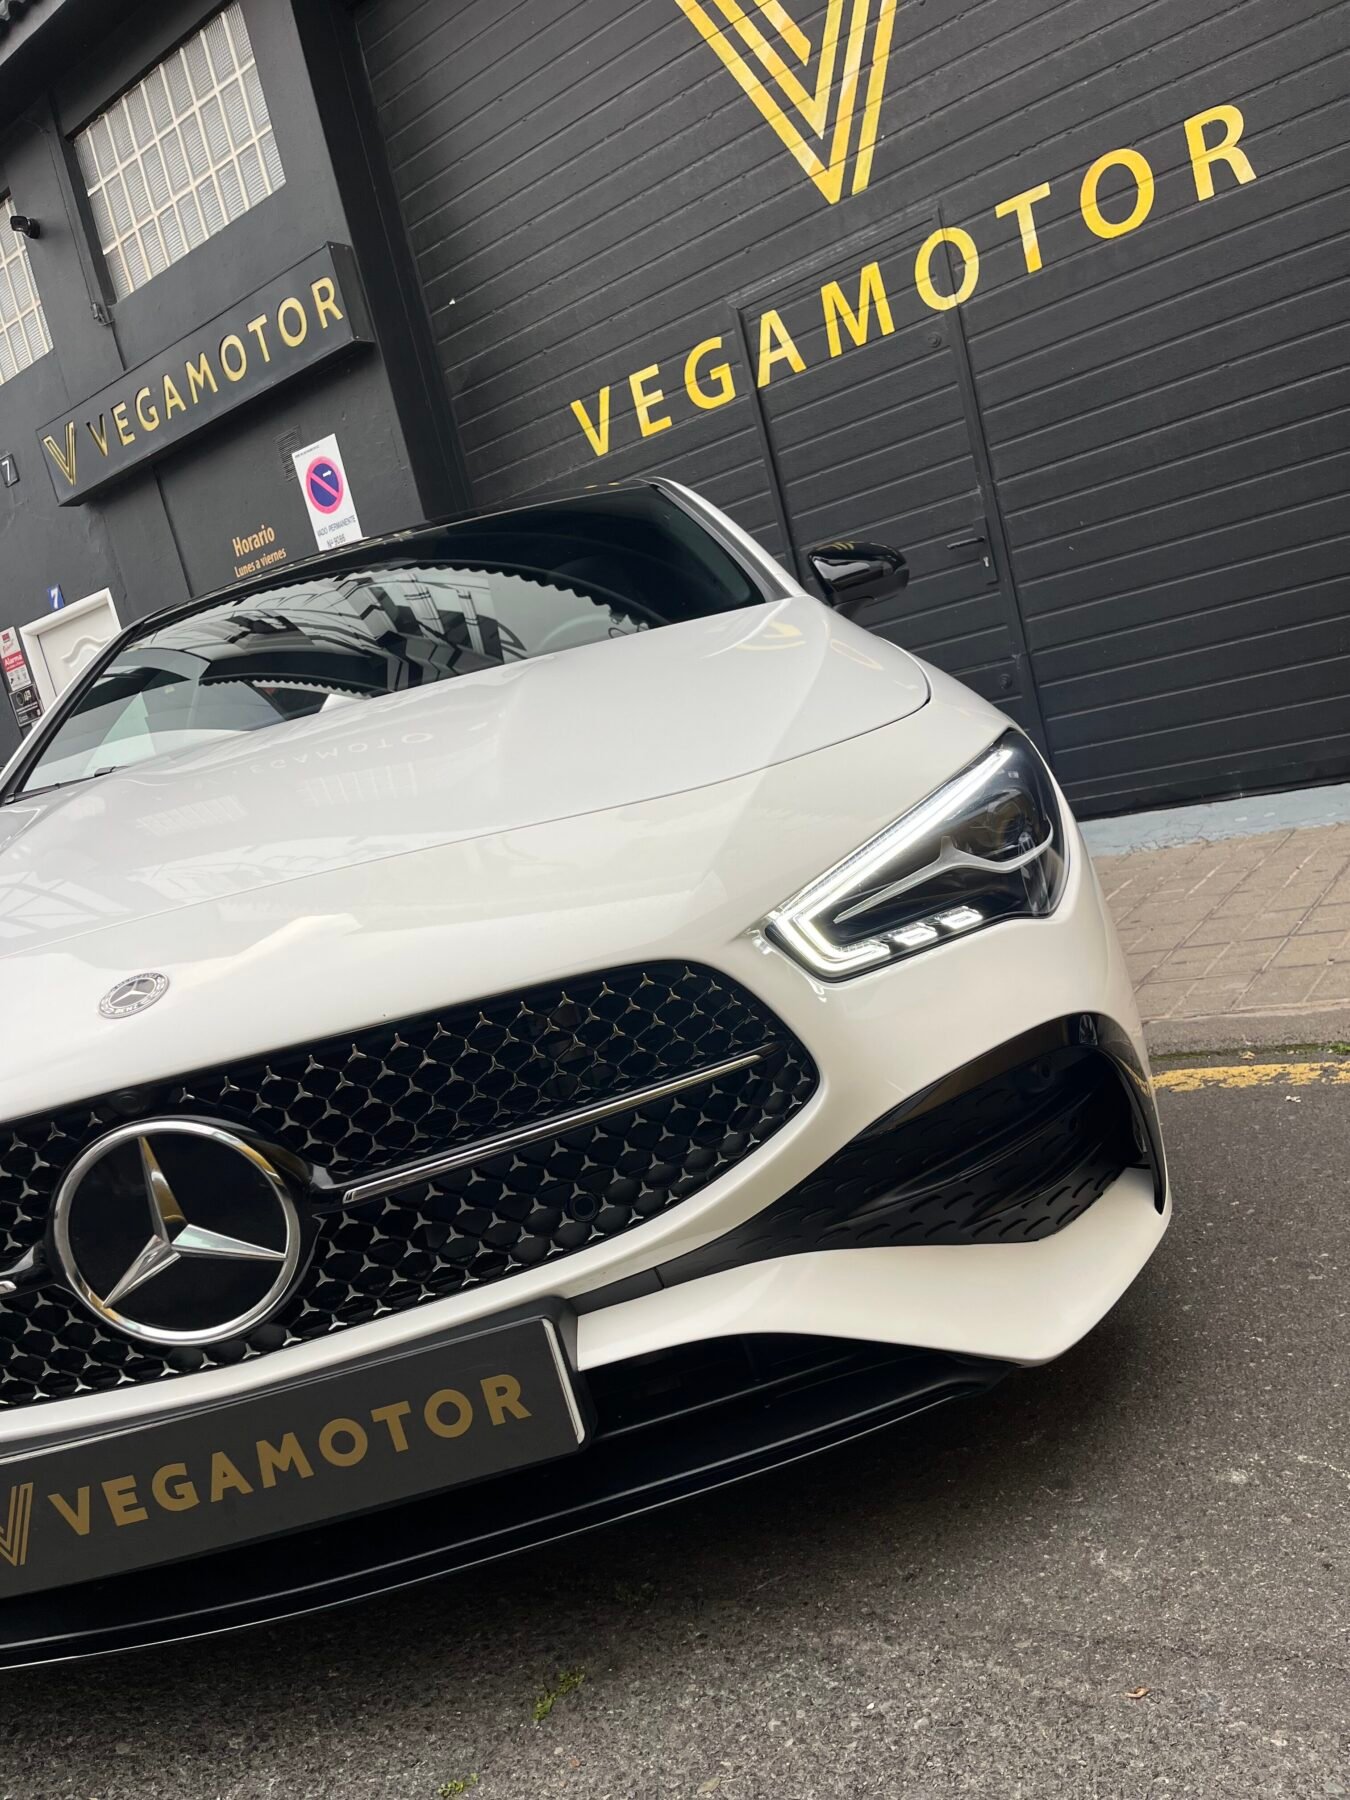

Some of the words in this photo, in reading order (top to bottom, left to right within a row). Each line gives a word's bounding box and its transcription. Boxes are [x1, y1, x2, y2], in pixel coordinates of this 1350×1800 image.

[572, 104, 1256, 456] VEGAMOTOR
[86, 277, 344, 457] VEGAMOTOR
[2, 460, 11, 482] 7
[232, 524, 275, 557] Horario
[234, 561, 256, 578] Lunes
[255, 559, 261, 569] a
[260, 548, 287, 567] viernes
[50, 588, 59, 609] 7
[48, 1374, 532, 1536] VEGAMOTOR
